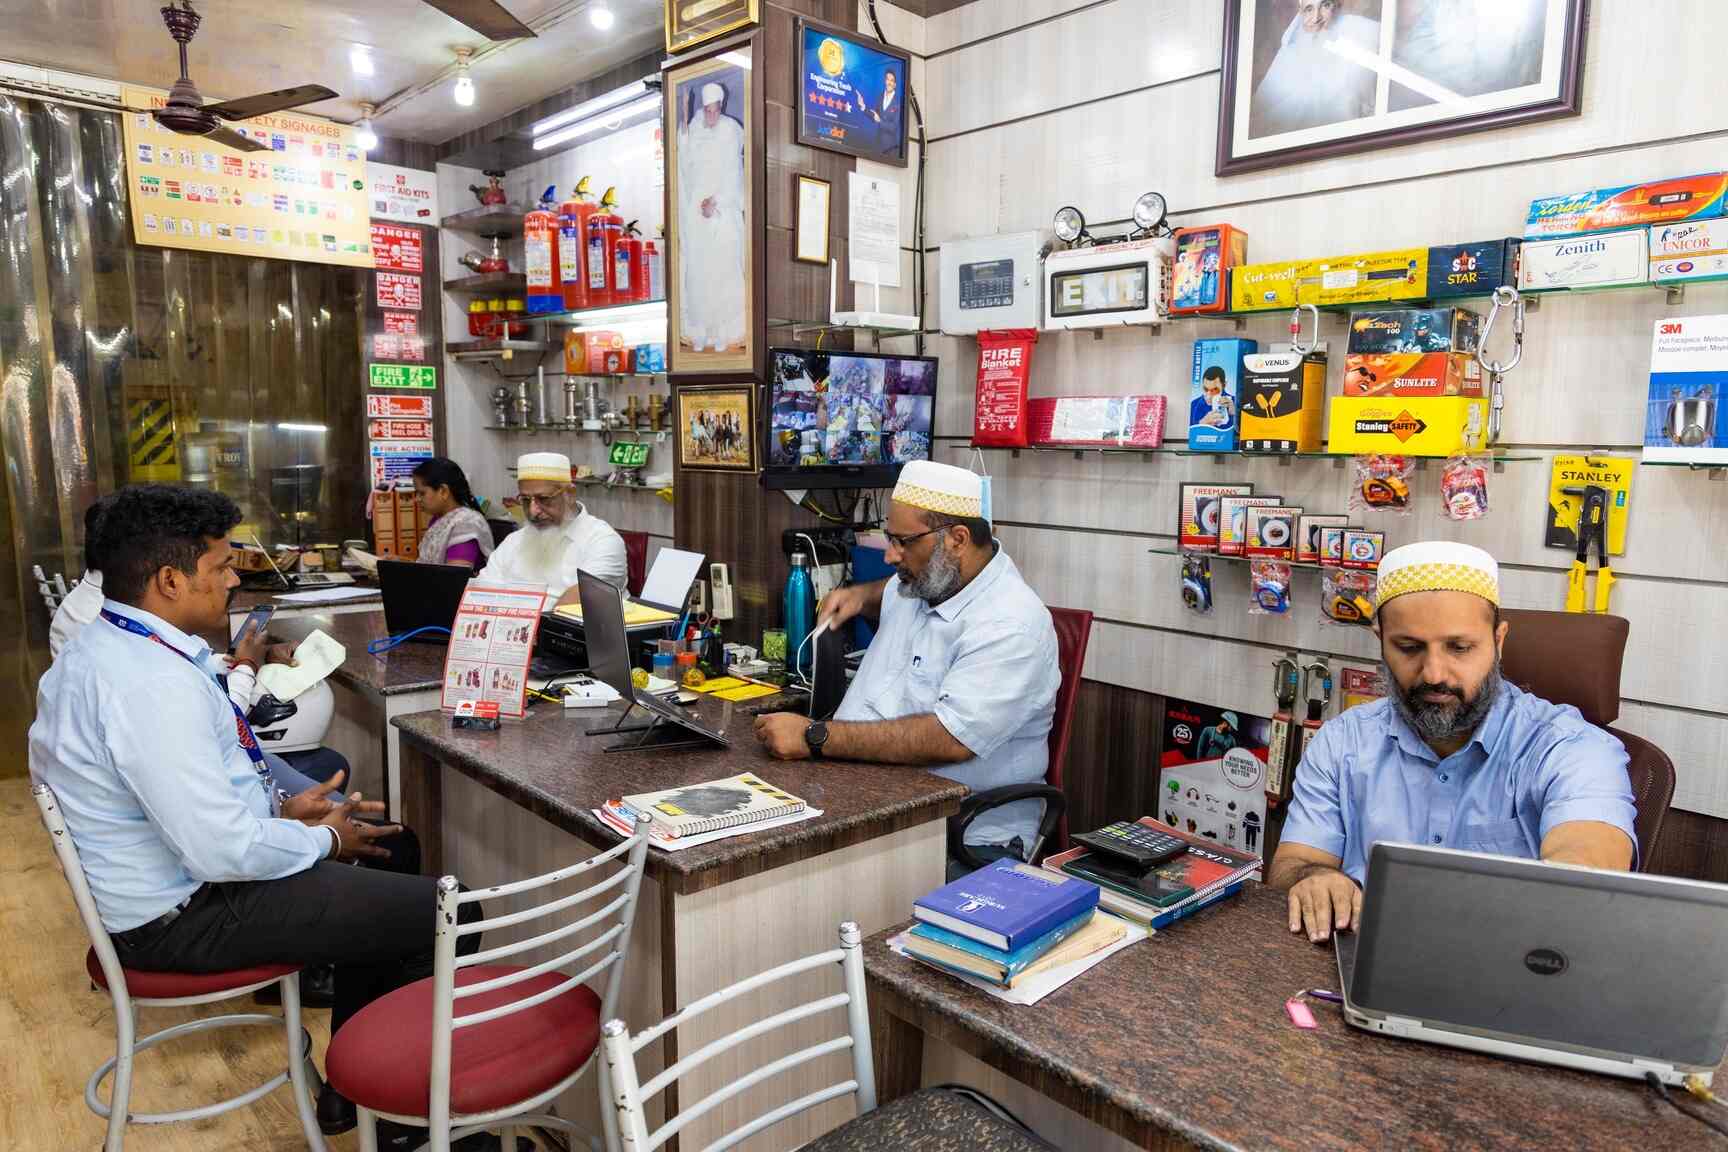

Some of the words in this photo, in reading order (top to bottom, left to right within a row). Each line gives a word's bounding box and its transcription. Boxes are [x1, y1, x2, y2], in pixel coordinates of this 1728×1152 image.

[282, 119, 341, 138] SIGNAGES
[398, 187, 411, 197] AID
[413, 189, 430, 199] KITS
[369, 227, 420, 240] DANGER
[1555, 240, 1607, 257] Zenith
[1663, 238, 1711, 251] UNICOR
[378, 272, 421, 284] DANGER
[1243, 266, 1297, 283] Cut-well
[1447, 272, 1477, 285] STAR
[1660, 323, 1682, 334] 3M
[982, 347, 1023, 360] FIRE
[981, 359, 1022, 369] Blanket
[375, 366, 404, 377] FIRE
[373, 375, 406, 386] EXIT
[1393, 377, 1438, 388] SUNLITE
[1391, 422, 1417, 431] SAFETY
[1561, 470, 1622, 483] STANLEY
[1193, 487, 1238, 496] FREEMANS
[1176, 727, 1189, 739] 25
[1225, 760, 1239, 769] YOUR
[1240, 764, 1257, 774] NEEDS
[1229, 755, 1254, 767] KNOWING
[1231, 768, 1250, 778] BETTER
